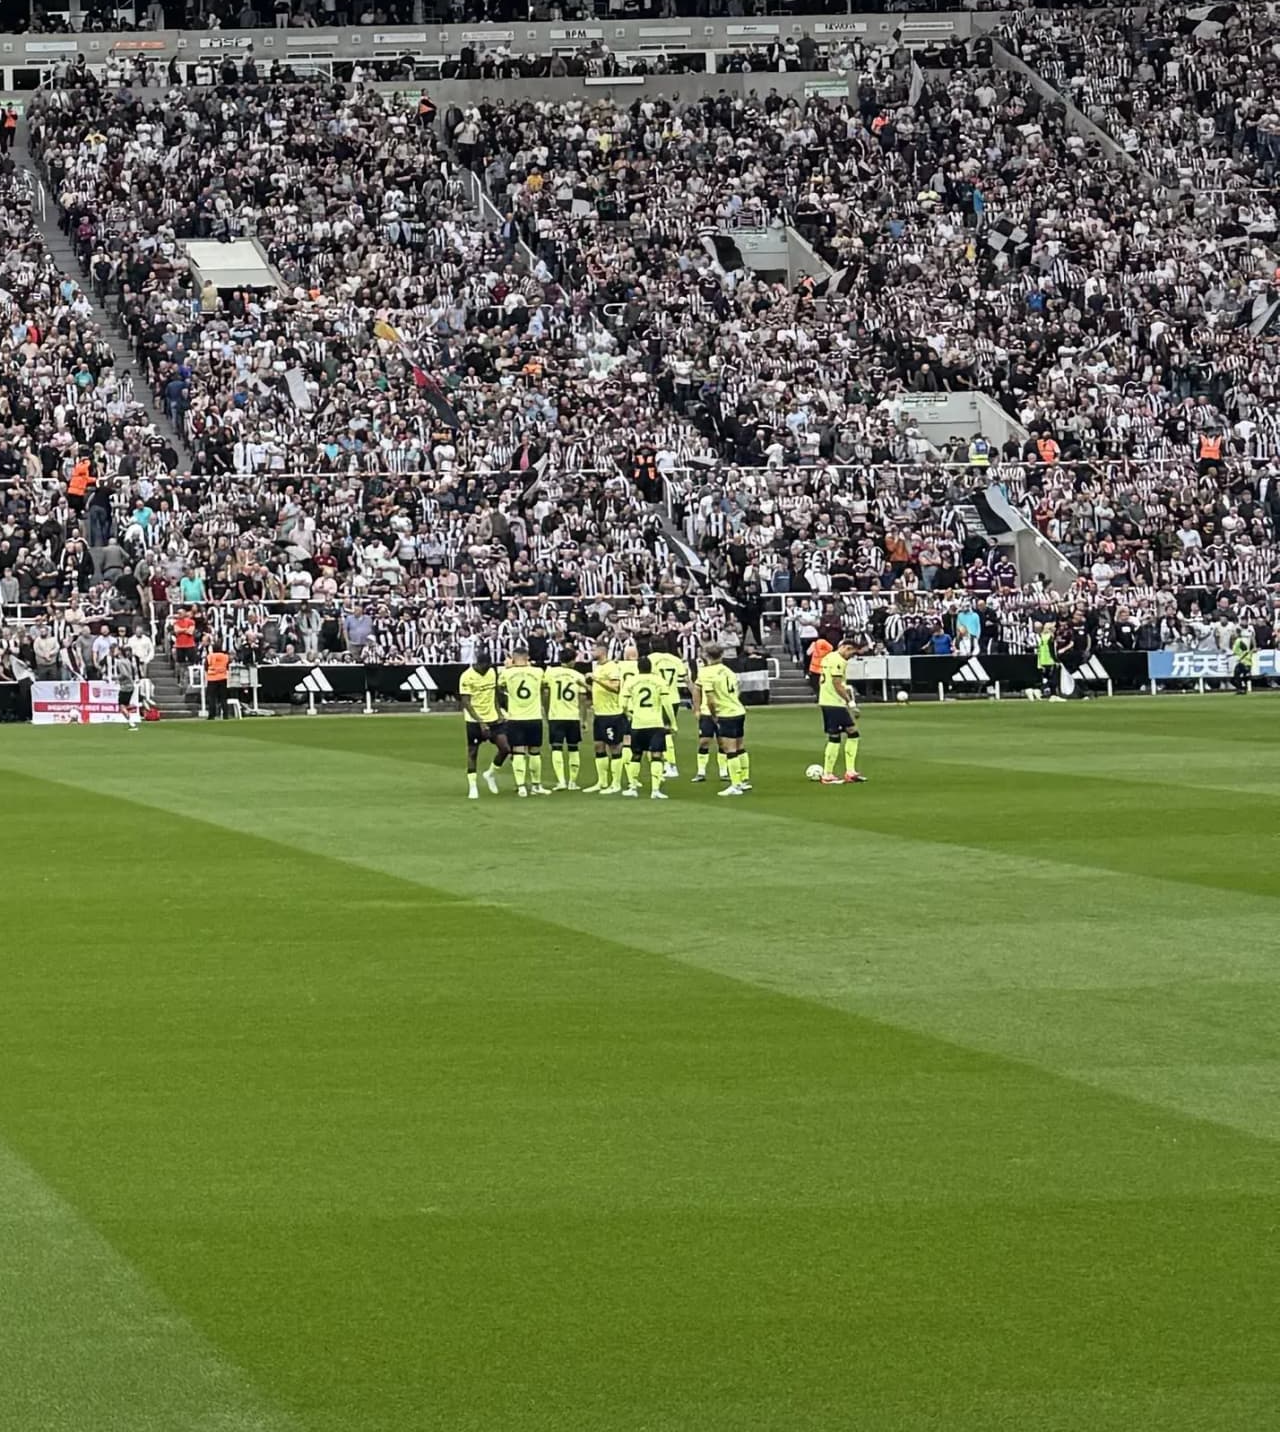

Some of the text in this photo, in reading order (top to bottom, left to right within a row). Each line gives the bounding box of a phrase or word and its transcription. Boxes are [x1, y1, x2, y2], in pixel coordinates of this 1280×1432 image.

[516, 680, 531, 699] 6
[555, 680, 575, 701] 16
[639, 687, 652, 707] 2
